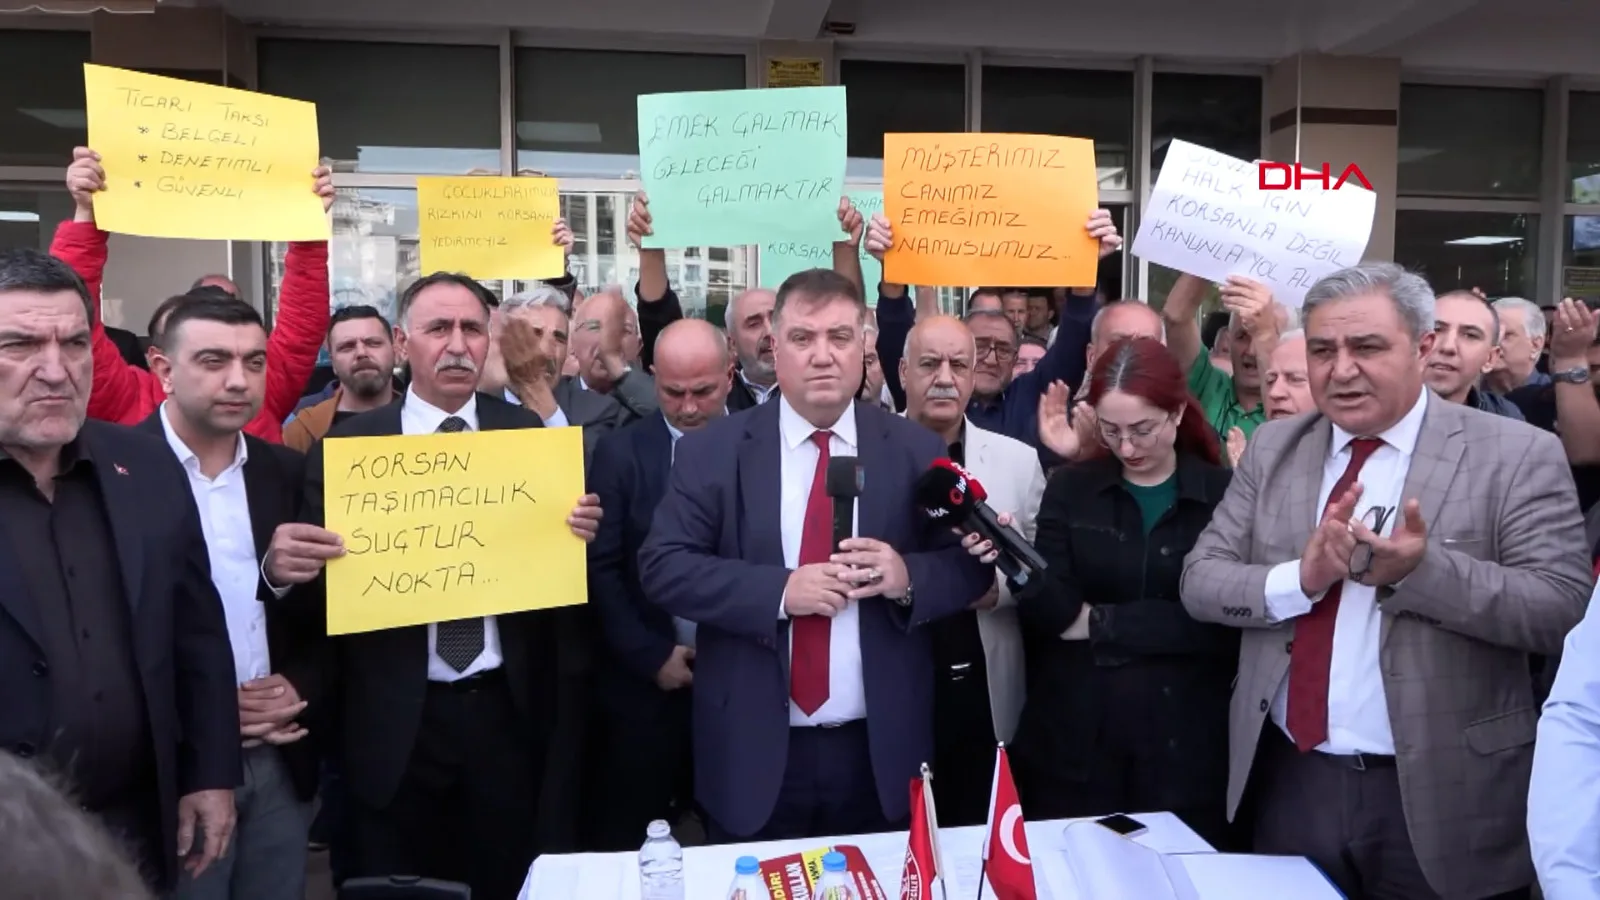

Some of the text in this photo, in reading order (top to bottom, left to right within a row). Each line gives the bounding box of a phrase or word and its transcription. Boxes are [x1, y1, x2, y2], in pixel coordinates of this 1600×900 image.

[648, 114, 719, 145] EMEK
[1182, 166, 1244, 199] HALK
[346, 451, 472, 480] KORSAN
[340, 480, 537, 516] TAŞIMACILIK
[346, 520, 486, 555] SUÇTUR
